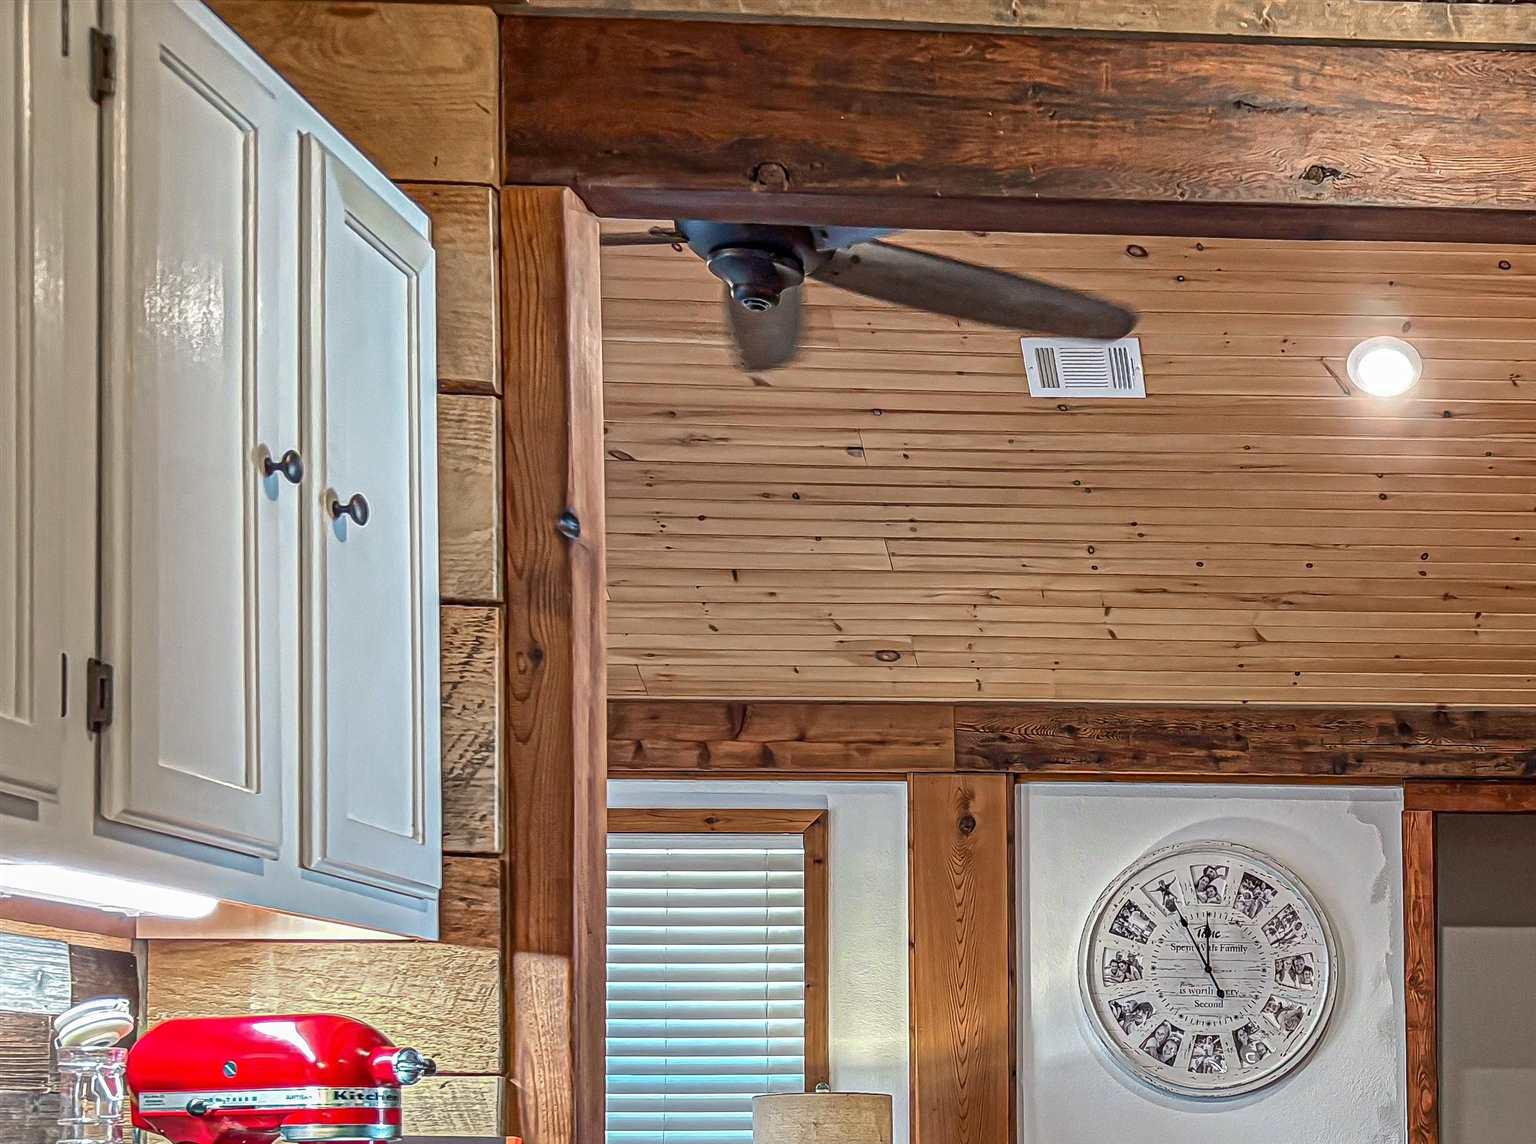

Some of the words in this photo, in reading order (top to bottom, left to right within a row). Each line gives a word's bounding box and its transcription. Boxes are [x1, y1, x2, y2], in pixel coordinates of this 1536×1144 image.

[1220, 944, 1248, 955] Family
[1188, 986, 1214, 995] worth
[1194, 999, 1224, 1009] Second
